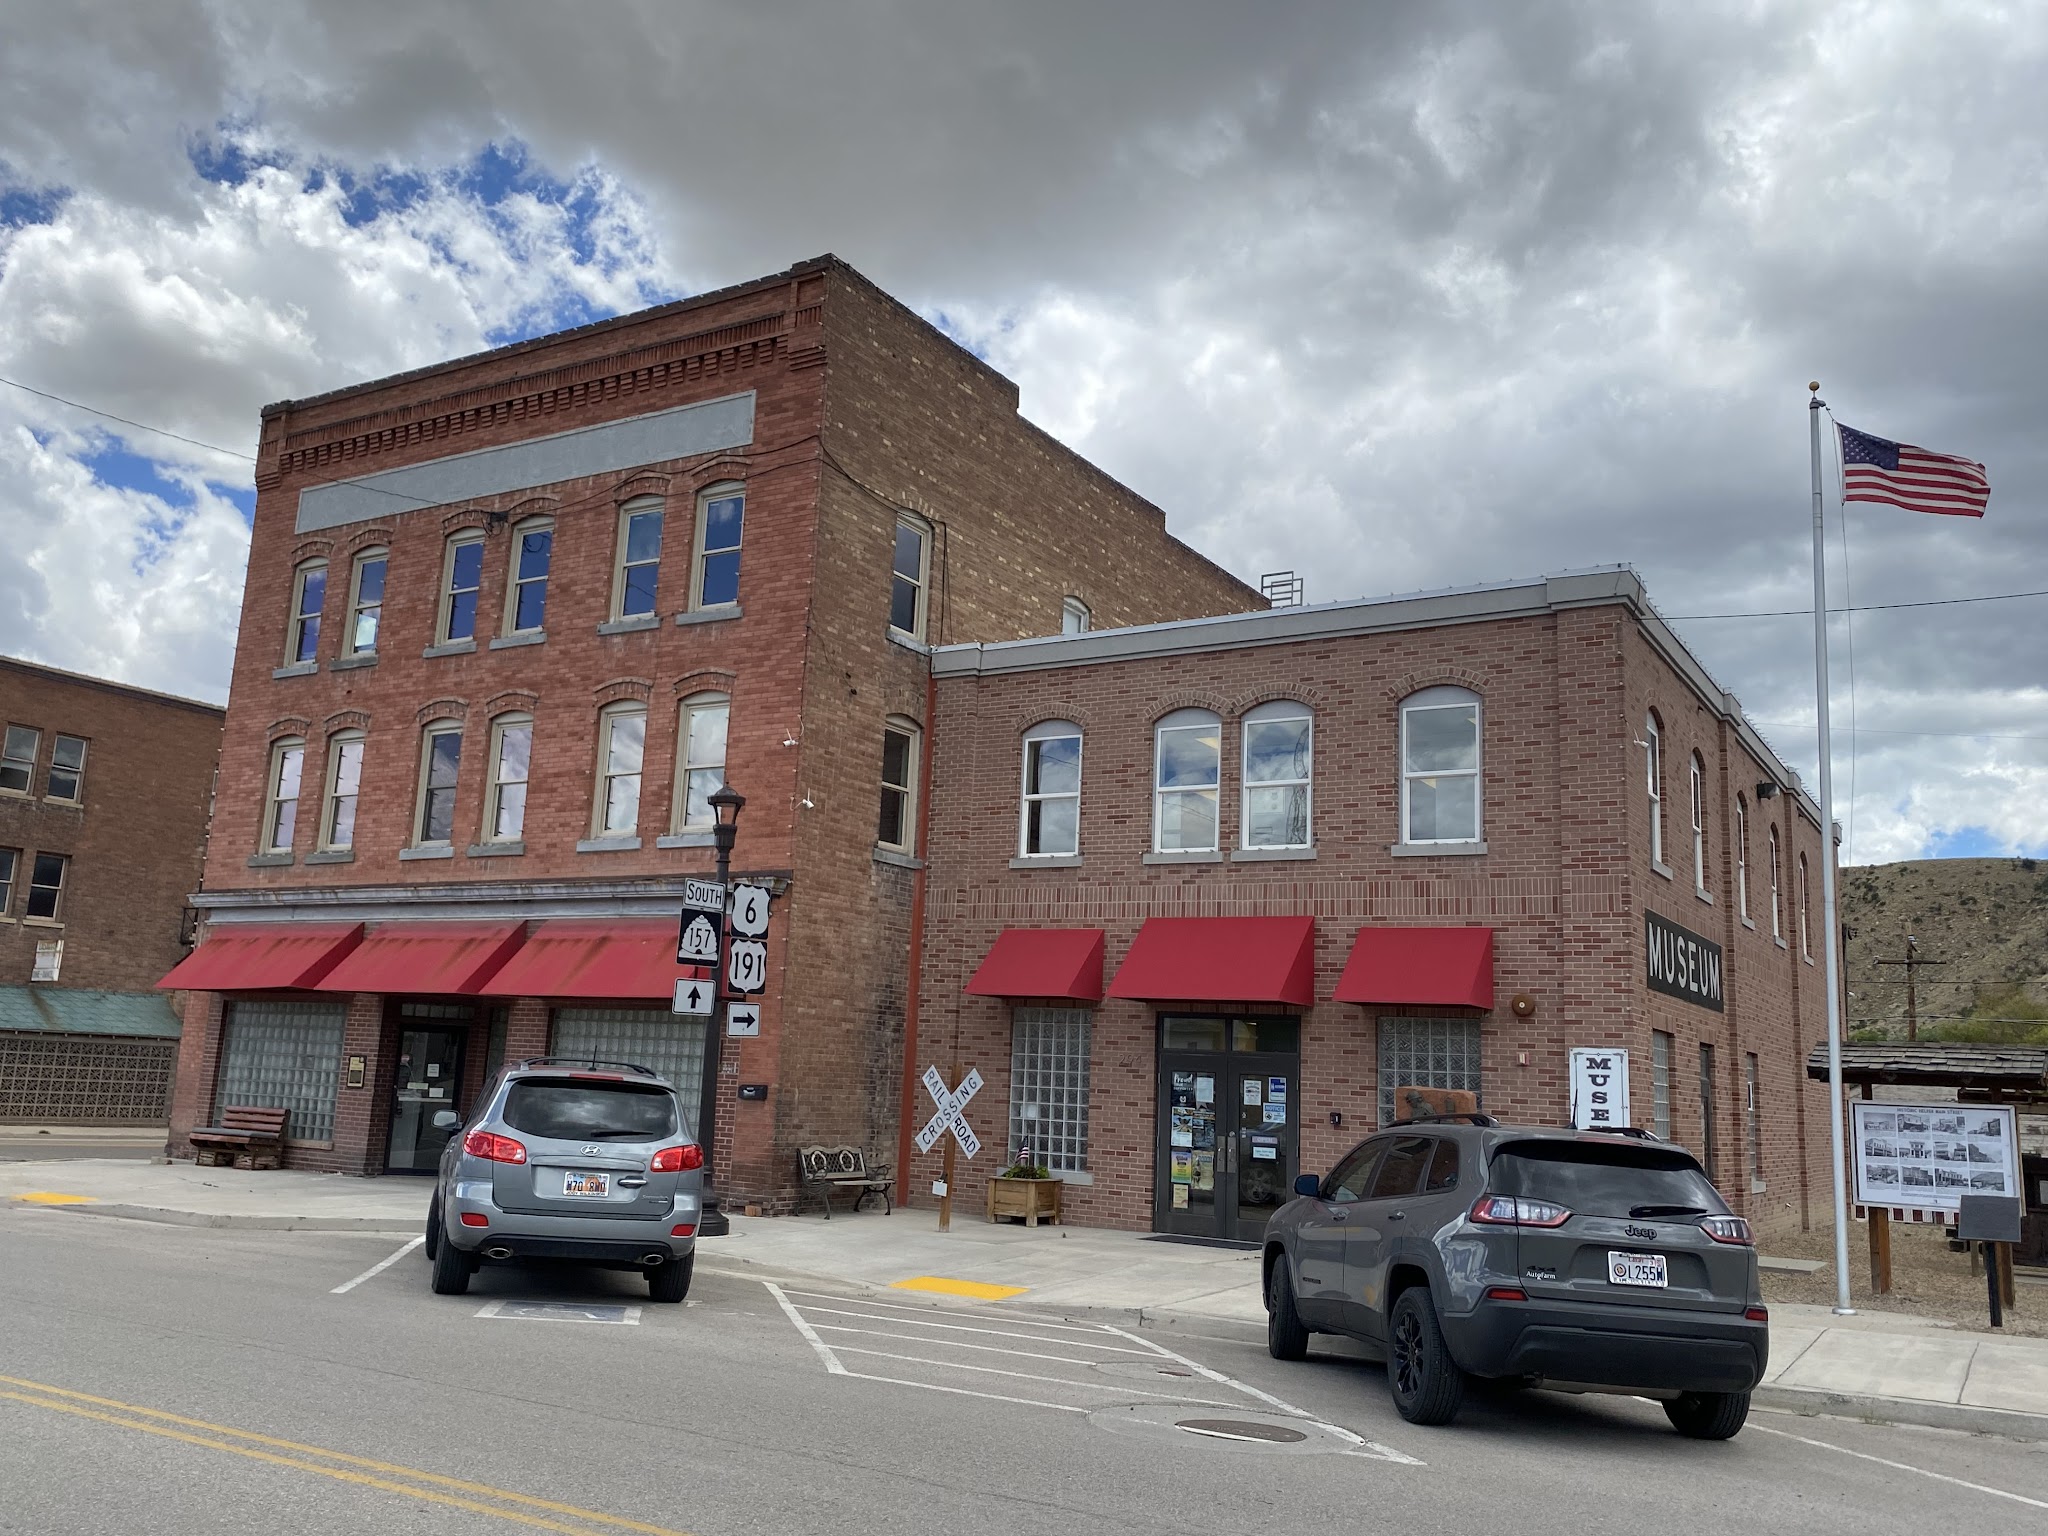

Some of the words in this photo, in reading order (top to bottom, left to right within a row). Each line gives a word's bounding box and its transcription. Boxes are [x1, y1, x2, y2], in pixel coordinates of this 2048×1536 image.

[687, 883, 722, 905] SOUTH
[745, 897, 757, 924] 6
[689, 927, 711, 949] 157
[734, 951, 762, 982] 191
[1648, 921, 1721, 1001] MUSEUM
[1586, 1057, 1612, 1128] MUSE
[922, 1077, 978, 1145] CROSSING
[925, 1070, 945, 1105] RAIL
[953, 1117, 977, 1154] ROAD
[1625, 1225, 1657, 1240] Jeep
